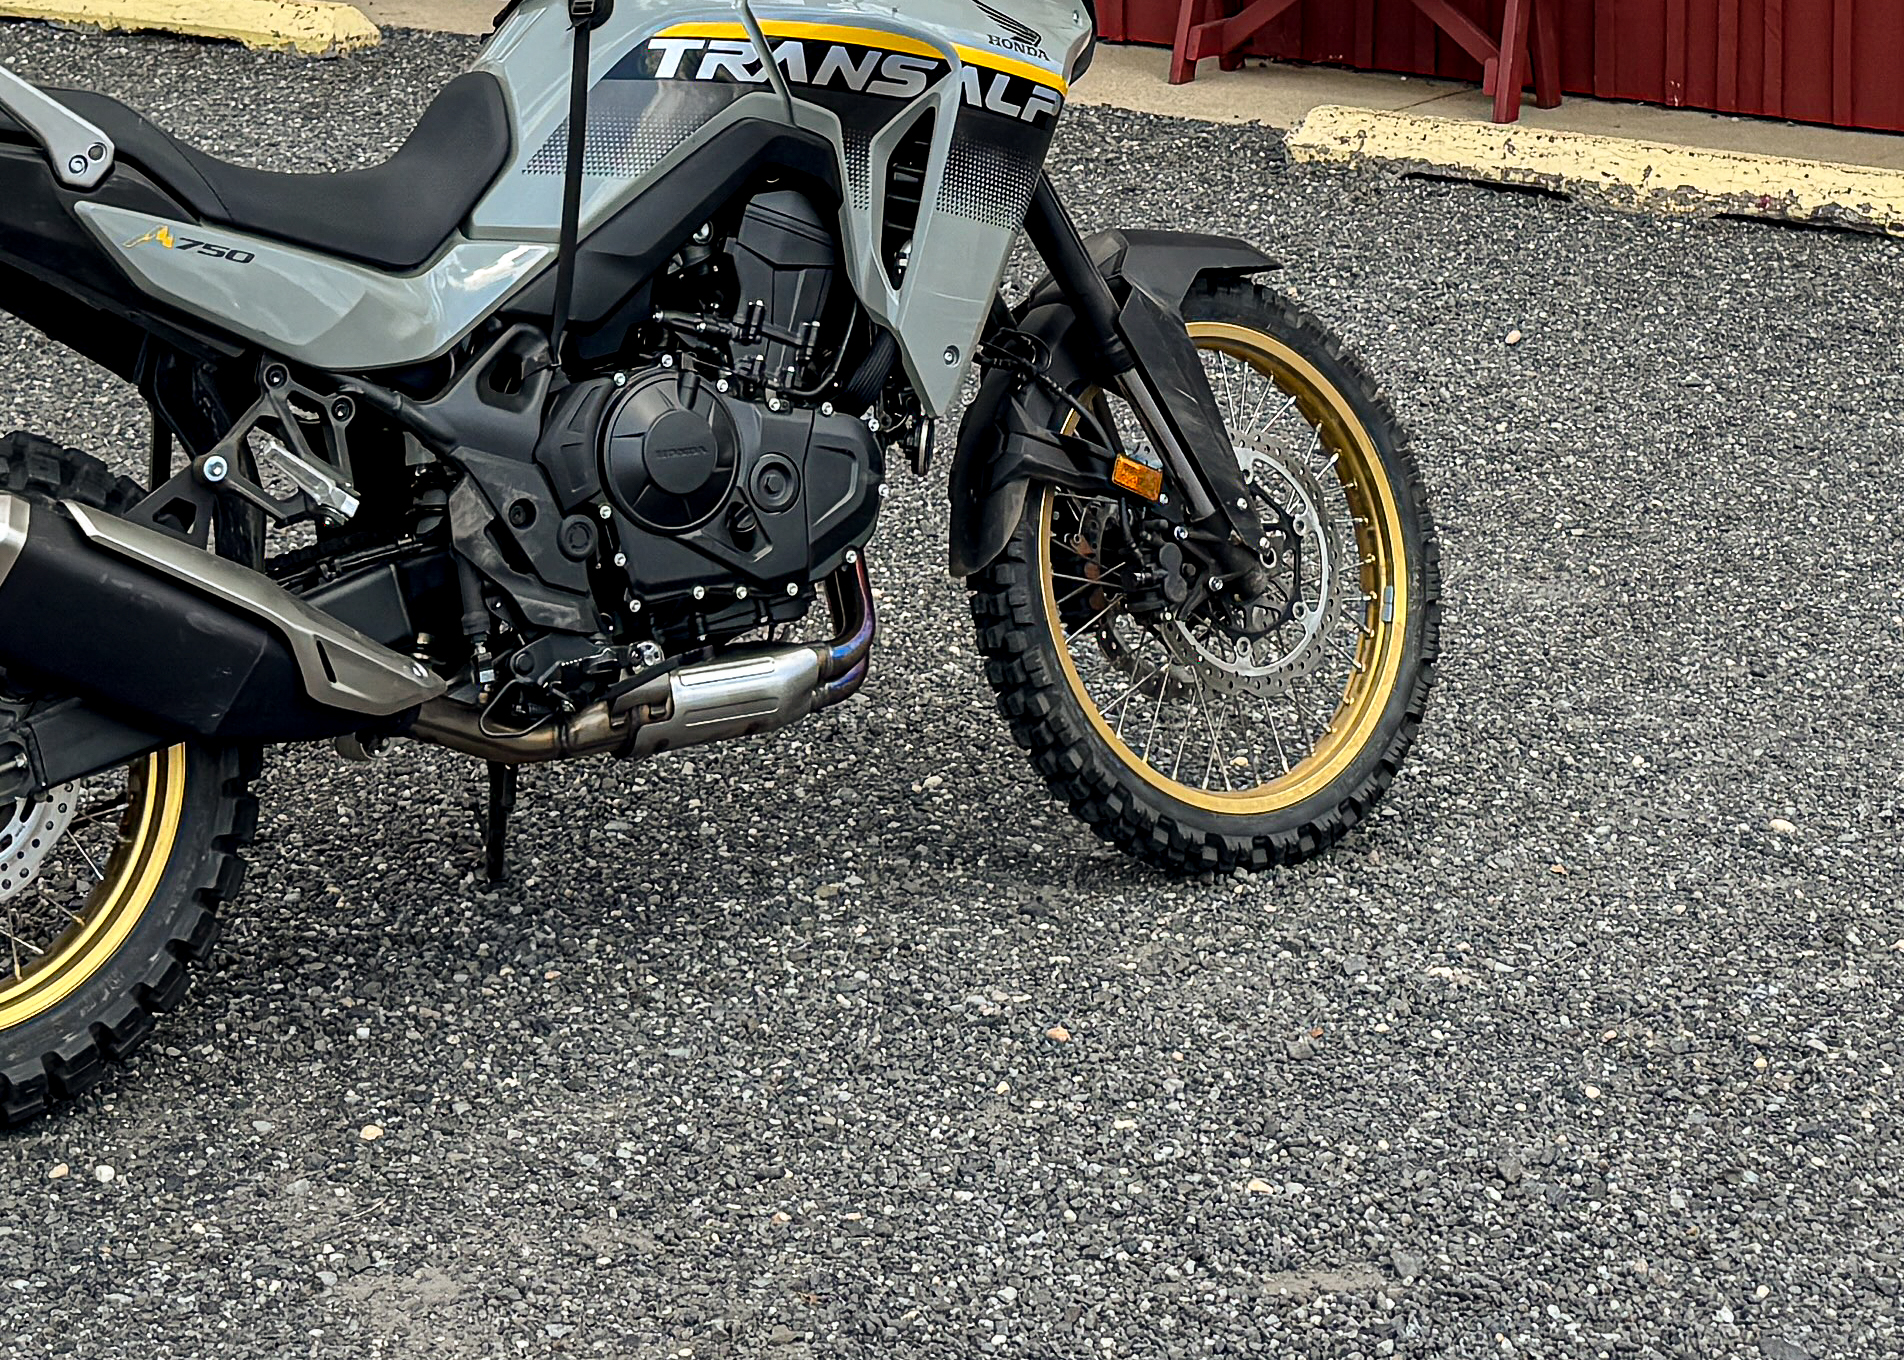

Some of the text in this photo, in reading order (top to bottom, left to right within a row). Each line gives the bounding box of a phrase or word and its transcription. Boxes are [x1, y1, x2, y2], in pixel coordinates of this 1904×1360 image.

[987, 34, 1052, 62] HONDA
[647, 37, 1061, 124] TRANSALP
[176, 237, 255, 264] 750
